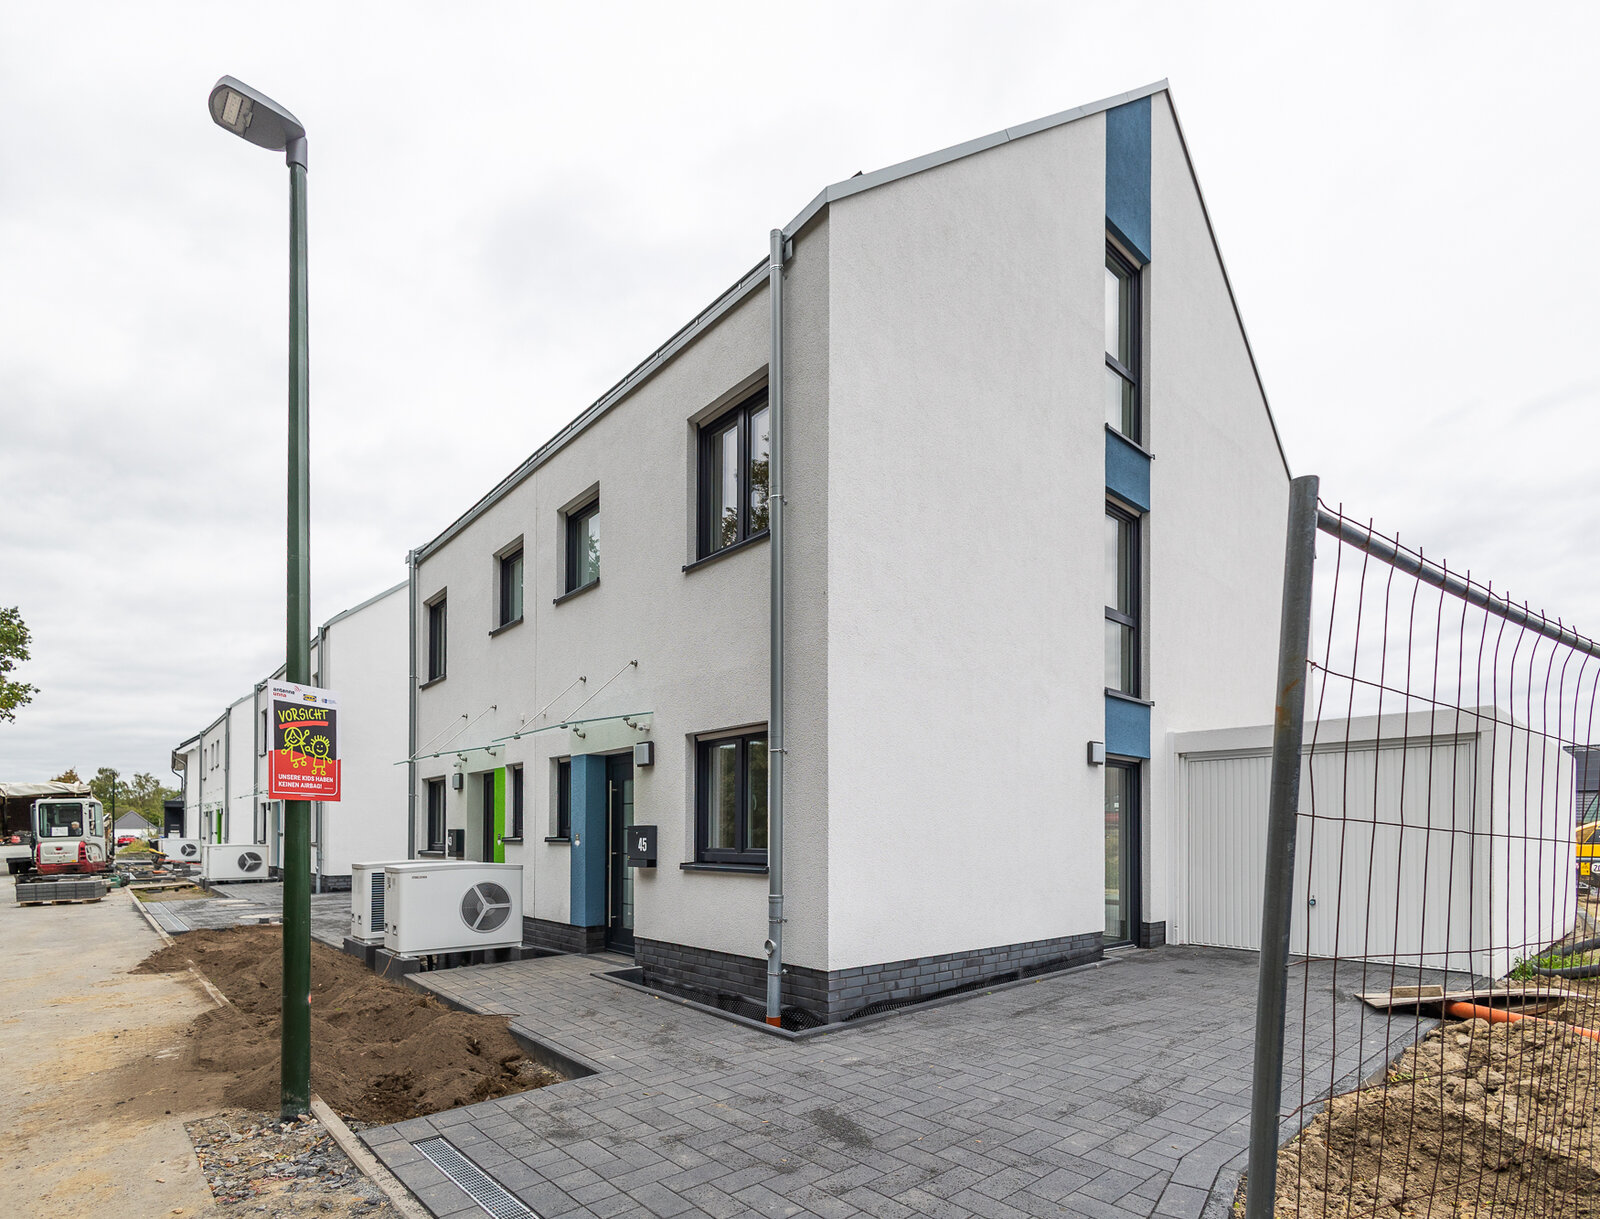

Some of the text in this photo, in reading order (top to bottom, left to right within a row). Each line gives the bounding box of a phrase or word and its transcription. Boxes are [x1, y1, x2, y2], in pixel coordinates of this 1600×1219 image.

[278, 708, 329, 723] VORSICHT
[278, 773, 301, 781] UNSERE
[637, 837, 648, 852] 45
